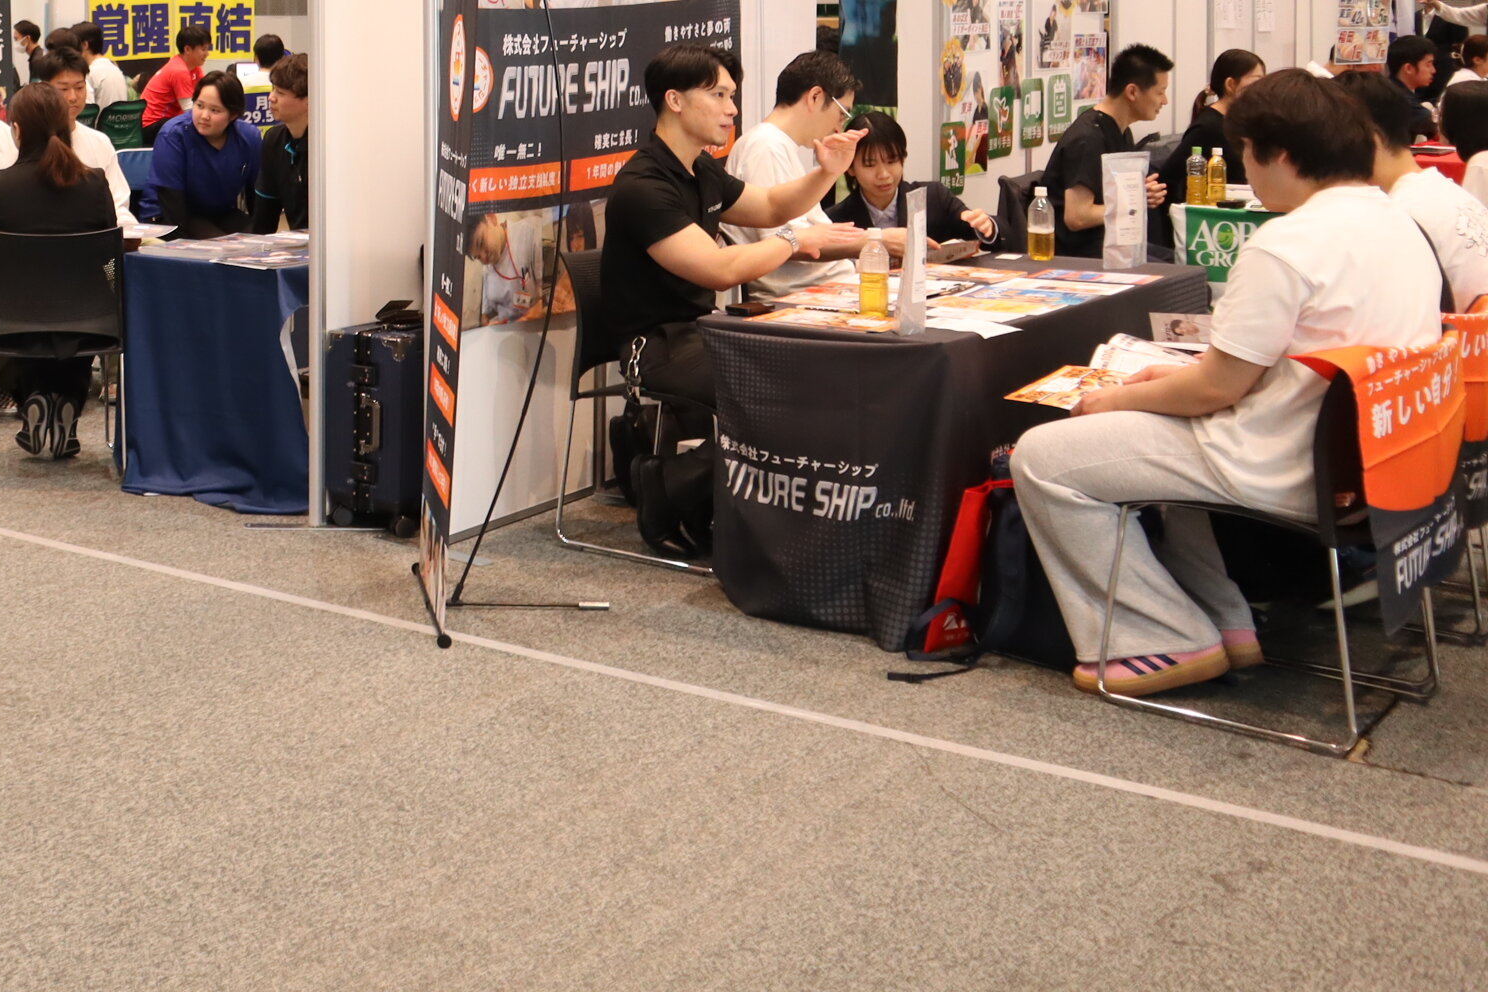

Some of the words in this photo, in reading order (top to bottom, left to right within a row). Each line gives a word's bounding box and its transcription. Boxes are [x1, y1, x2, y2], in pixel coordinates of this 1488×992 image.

[92, 3, 170, 56] 覚醒
[498, 63, 578, 119] FUTURE
[583, 58, 630, 112] SHIP
[494, 142, 542, 161] 唯一無二！
[720, 434, 880, 478] 株式会社フューチャーシップ
[813, 480, 878, 521] SHIP
